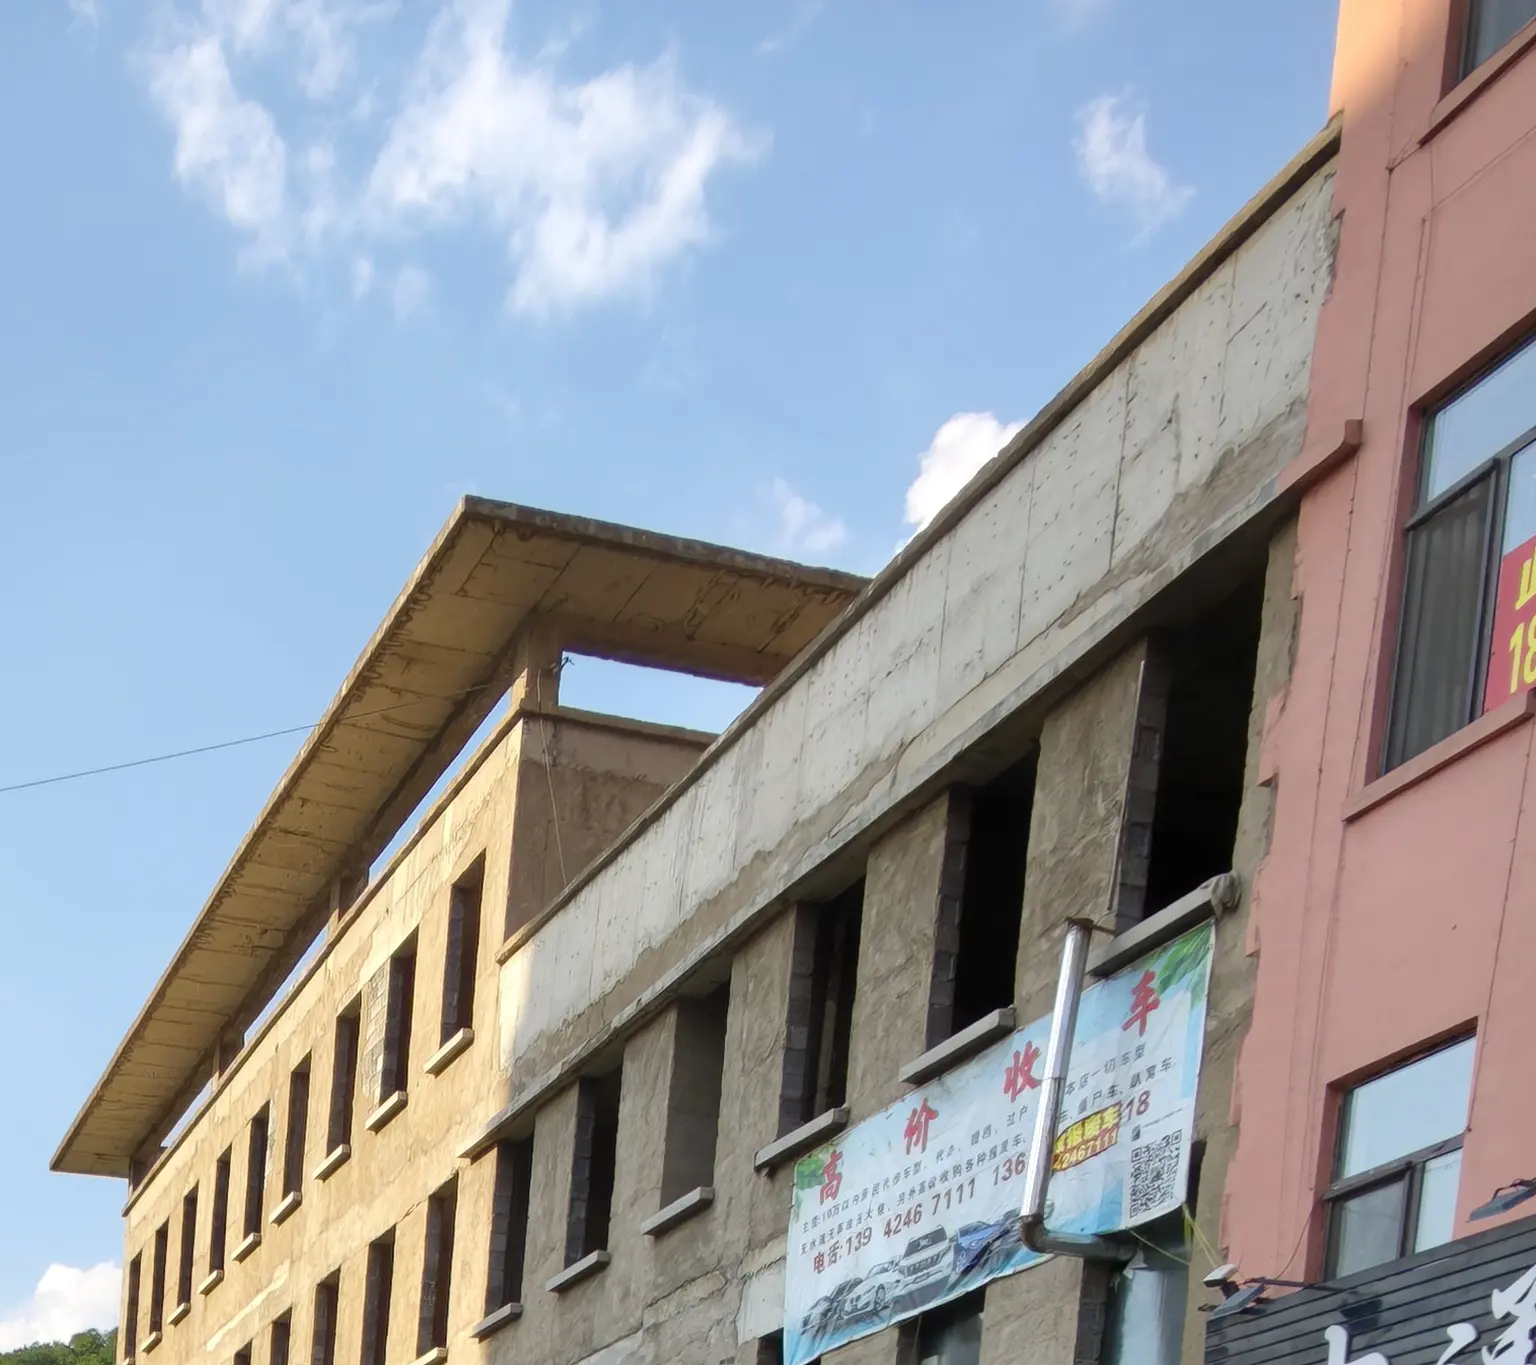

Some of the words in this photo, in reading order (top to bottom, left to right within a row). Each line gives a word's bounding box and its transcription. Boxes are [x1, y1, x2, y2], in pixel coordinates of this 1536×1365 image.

[884, 1203, 923, 1238] 4246
[932, 1177, 976, 1216] 7111
[993, 1151, 1026, 1187] 136
